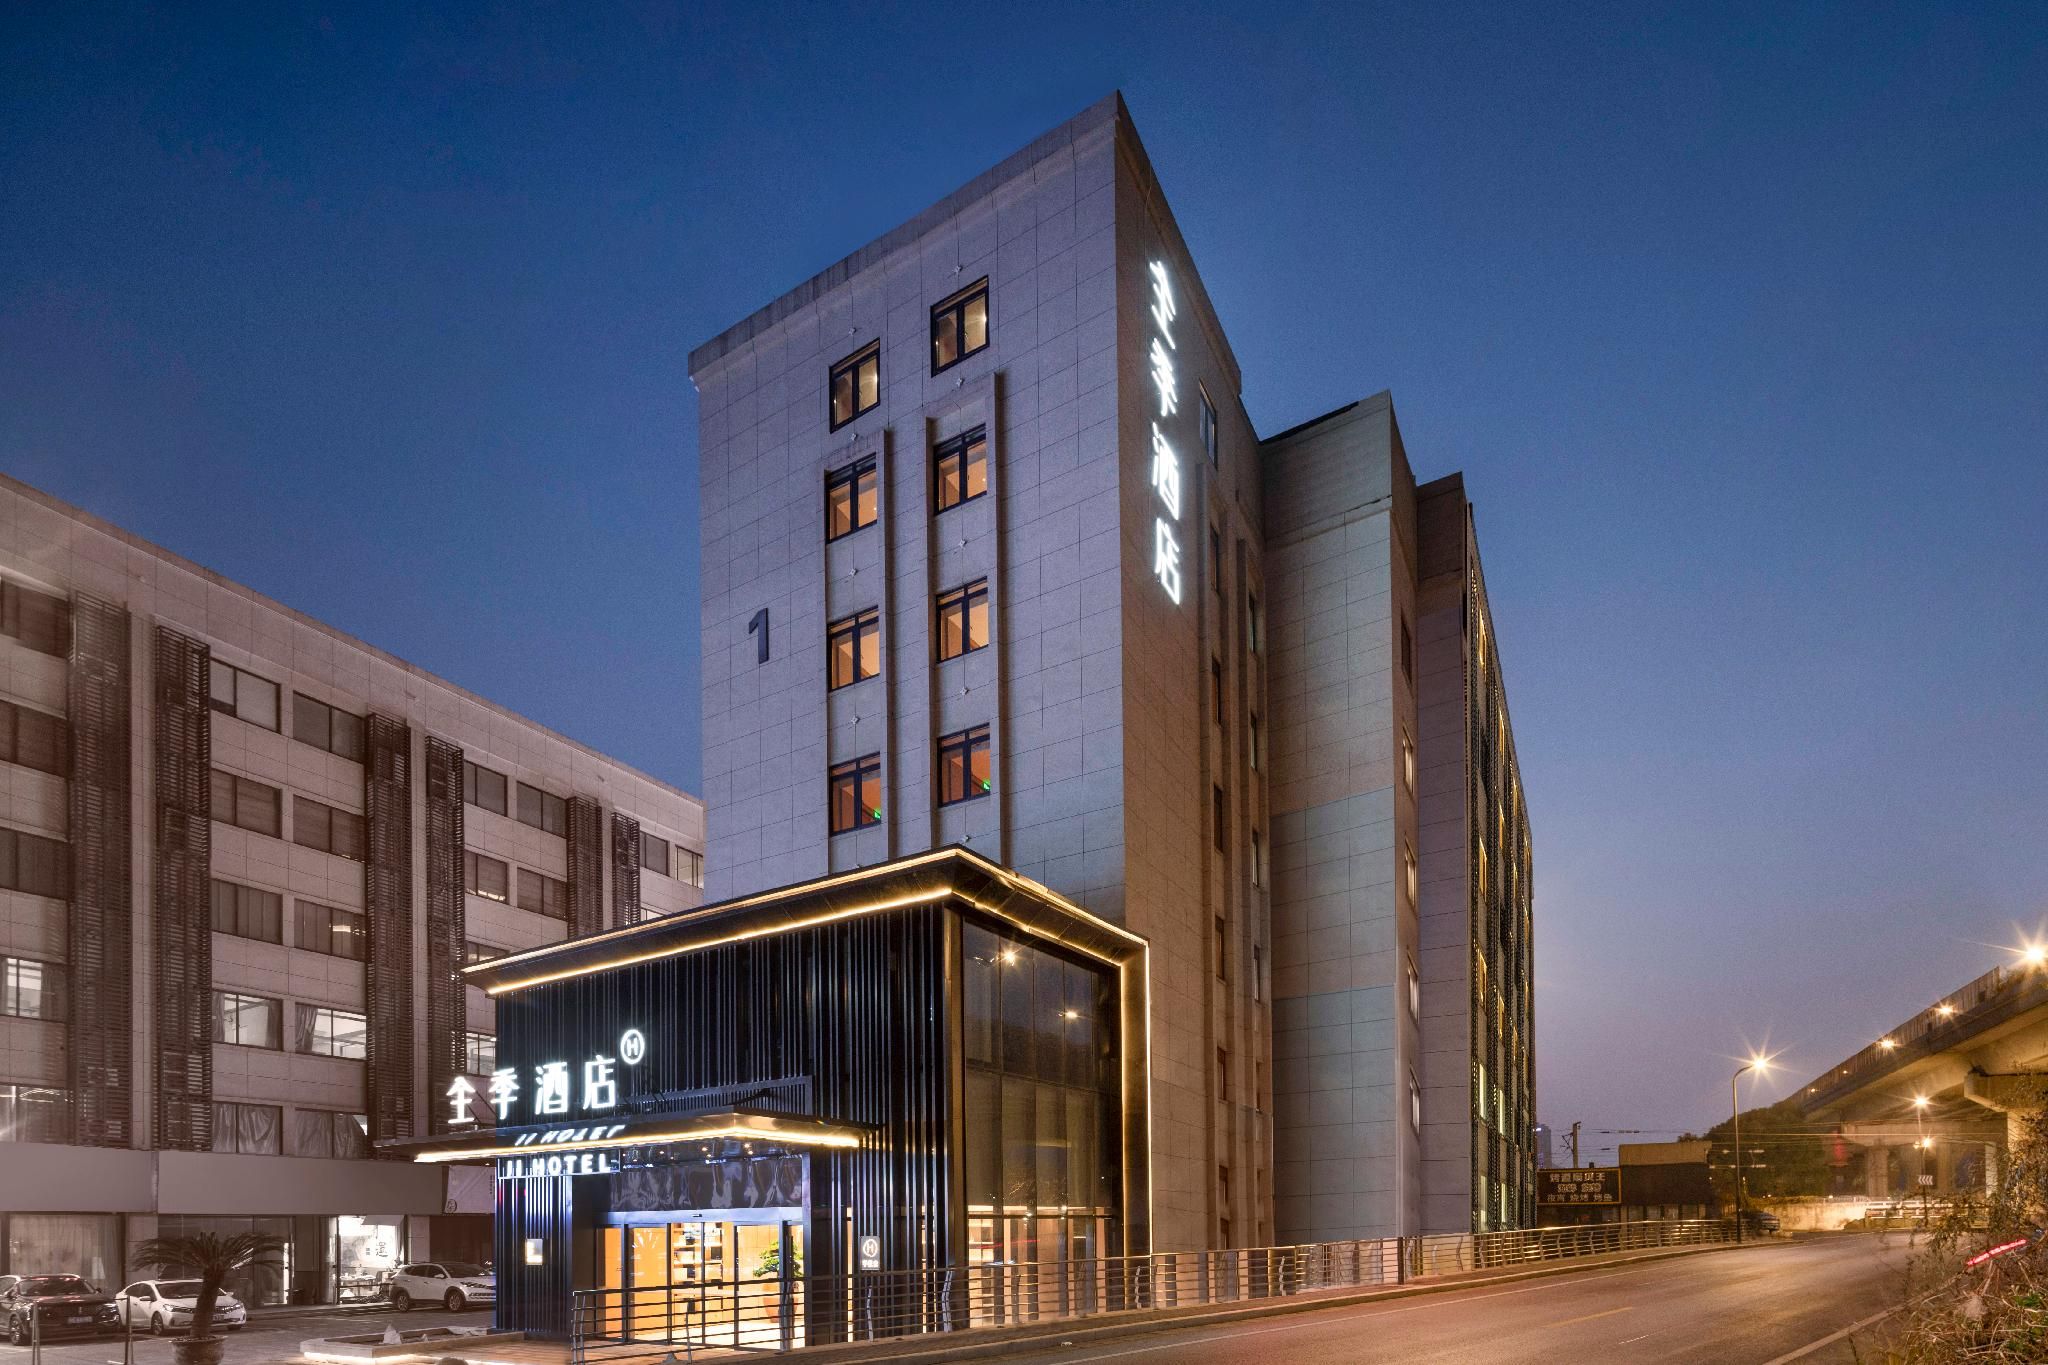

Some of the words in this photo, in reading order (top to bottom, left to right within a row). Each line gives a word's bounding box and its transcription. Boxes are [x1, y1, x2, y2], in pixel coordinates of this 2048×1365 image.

[1149, 260, 1181, 606] 全季酒店
[748, 607, 769, 664] 1
[446, 1054, 616, 1124] 全季酒店
[532, 1153, 611, 1176] HOTEL
